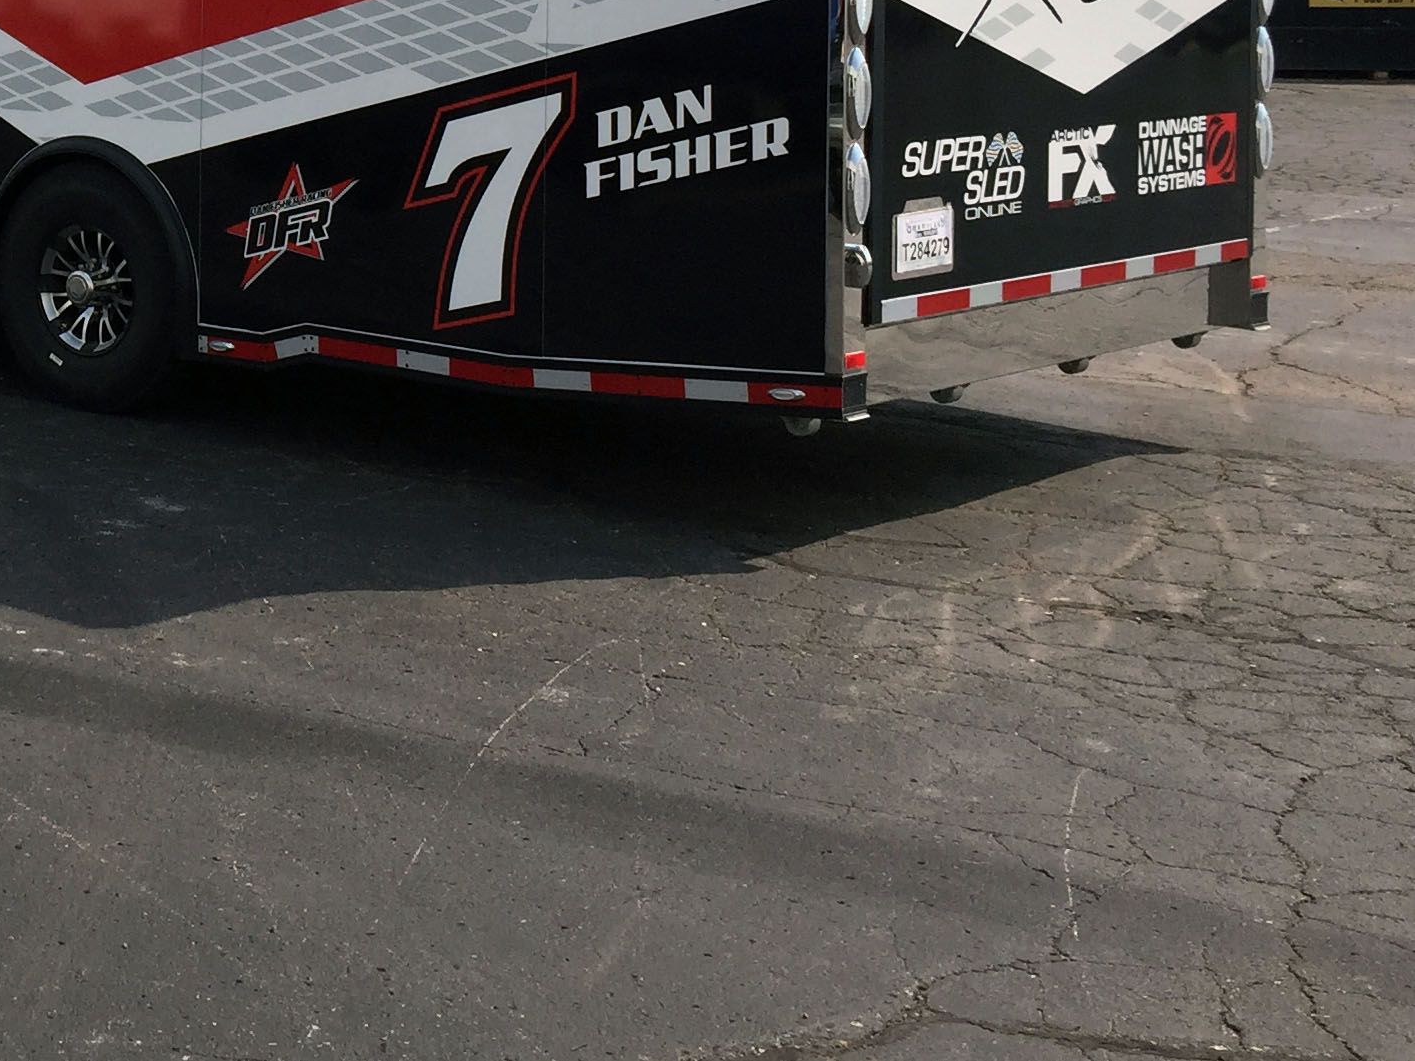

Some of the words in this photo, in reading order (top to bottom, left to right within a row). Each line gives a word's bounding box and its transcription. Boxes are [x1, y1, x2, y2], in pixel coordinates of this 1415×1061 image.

[595, 84, 712, 148] DAN
[1138, 115, 1207, 139] DUNNAGE
[584, 117, 789, 199] FISHER
[901, 135, 986, 178] SUPER
[1048, 124, 1117, 203] FX
[1137, 133, 1204, 175] WASH
[414, 81, 570, 321] 7
[963, 166, 1026, 205] SLED
[1137, 168, 1206, 195] SYSTEMS
[244, 199, 334, 258] DFR
[965, 201, 1023, 221] ONLINE
[902, 236, 950, 261] T284279
